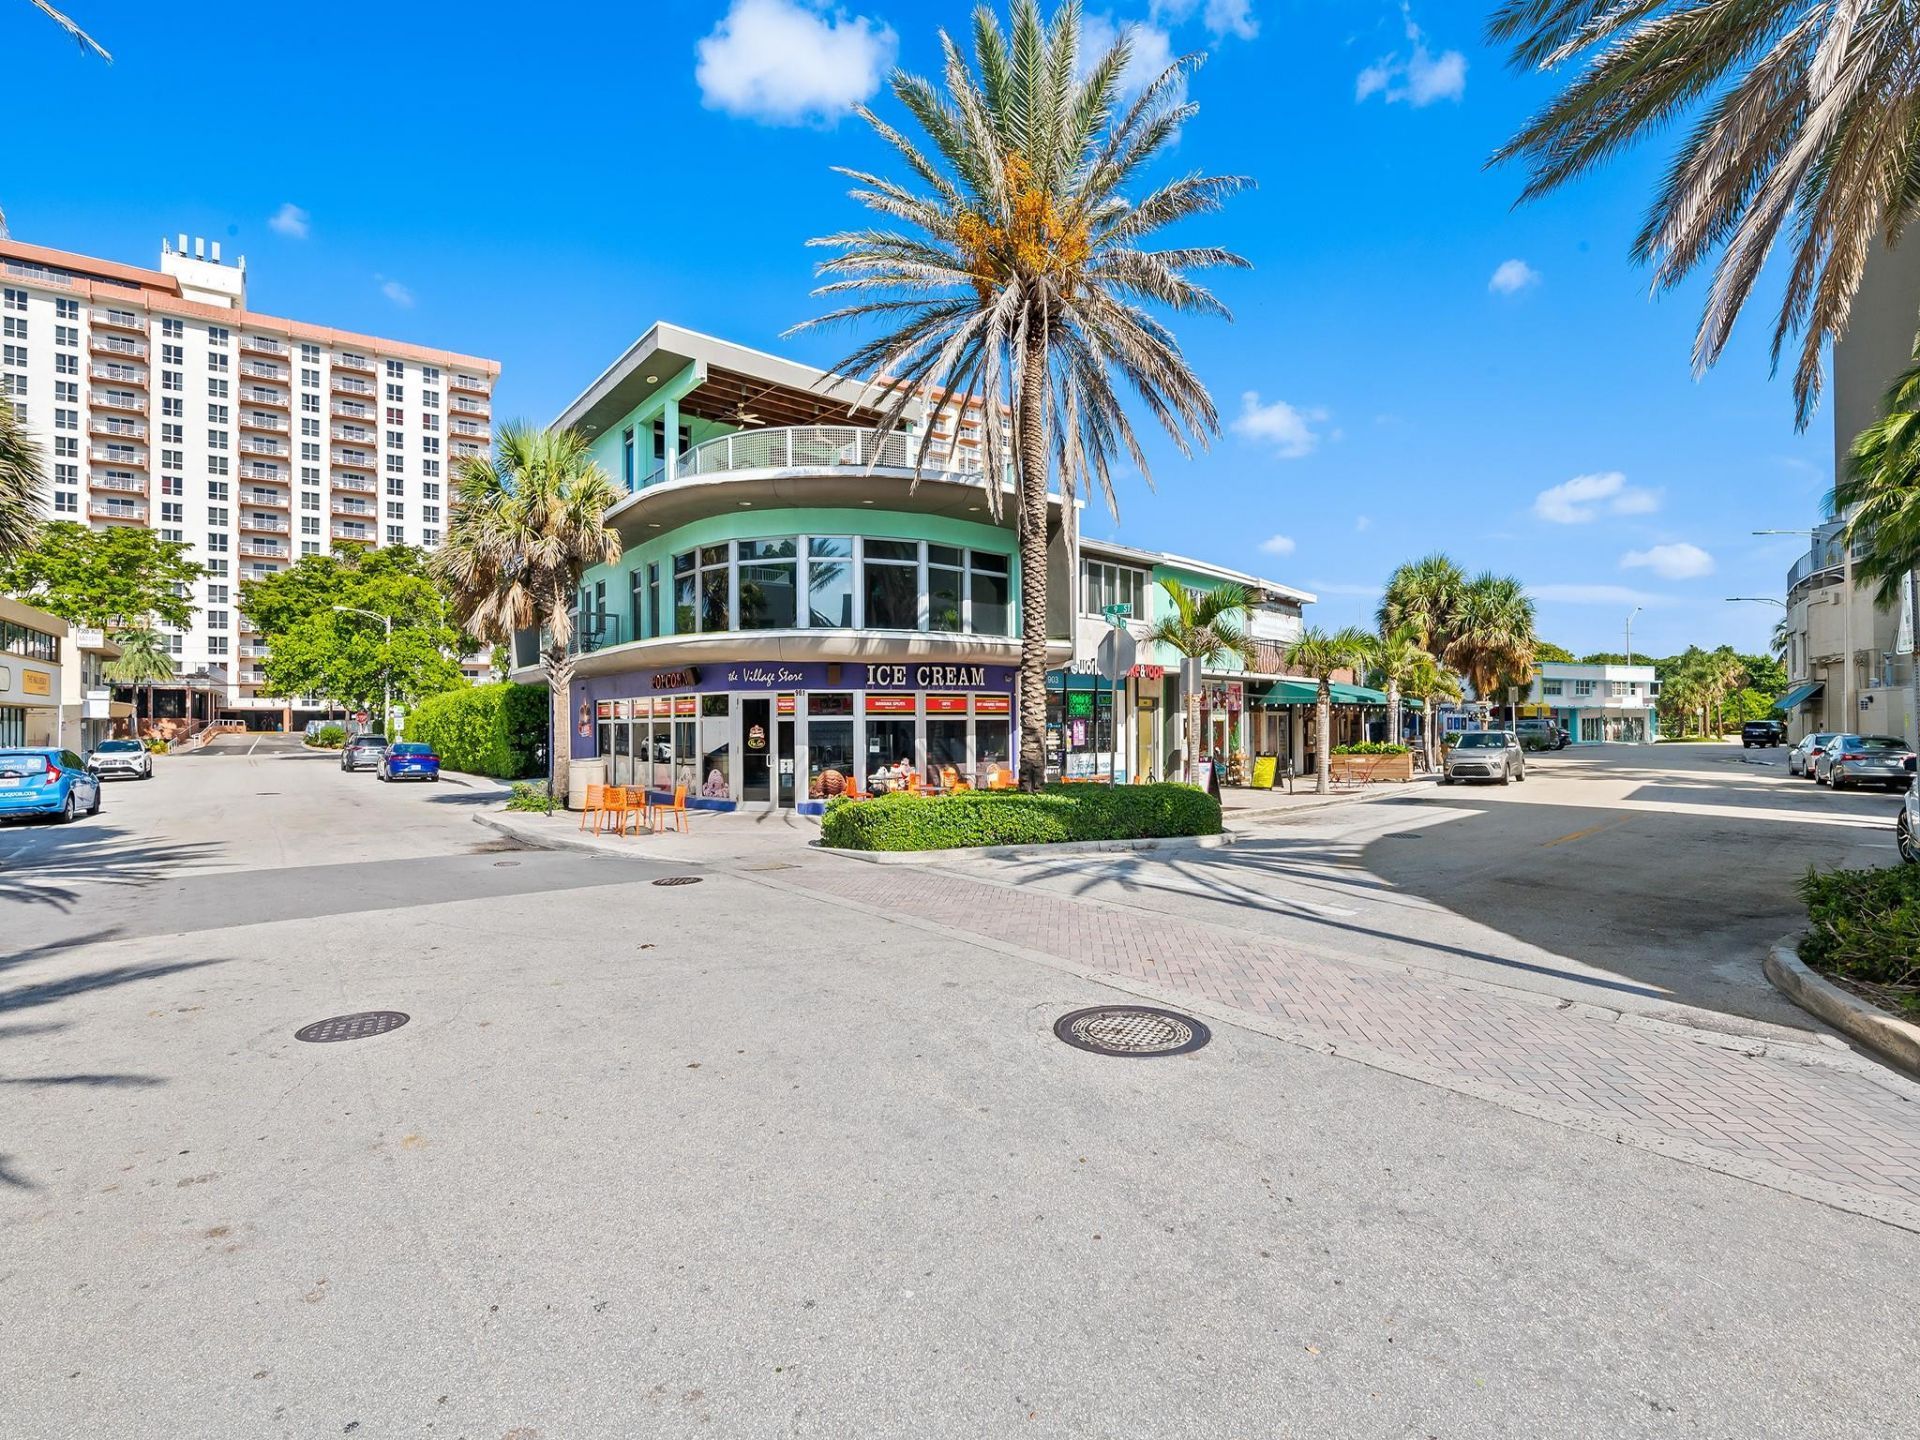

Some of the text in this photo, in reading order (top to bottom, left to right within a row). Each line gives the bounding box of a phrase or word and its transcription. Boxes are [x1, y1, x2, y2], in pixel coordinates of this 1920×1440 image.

[867, 665, 985, 686] ICE CREAM
[1078, 657, 1104, 676] worl
[728, 667, 803, 687] the Village Store
[1047, 676, 1060, 685] 903
